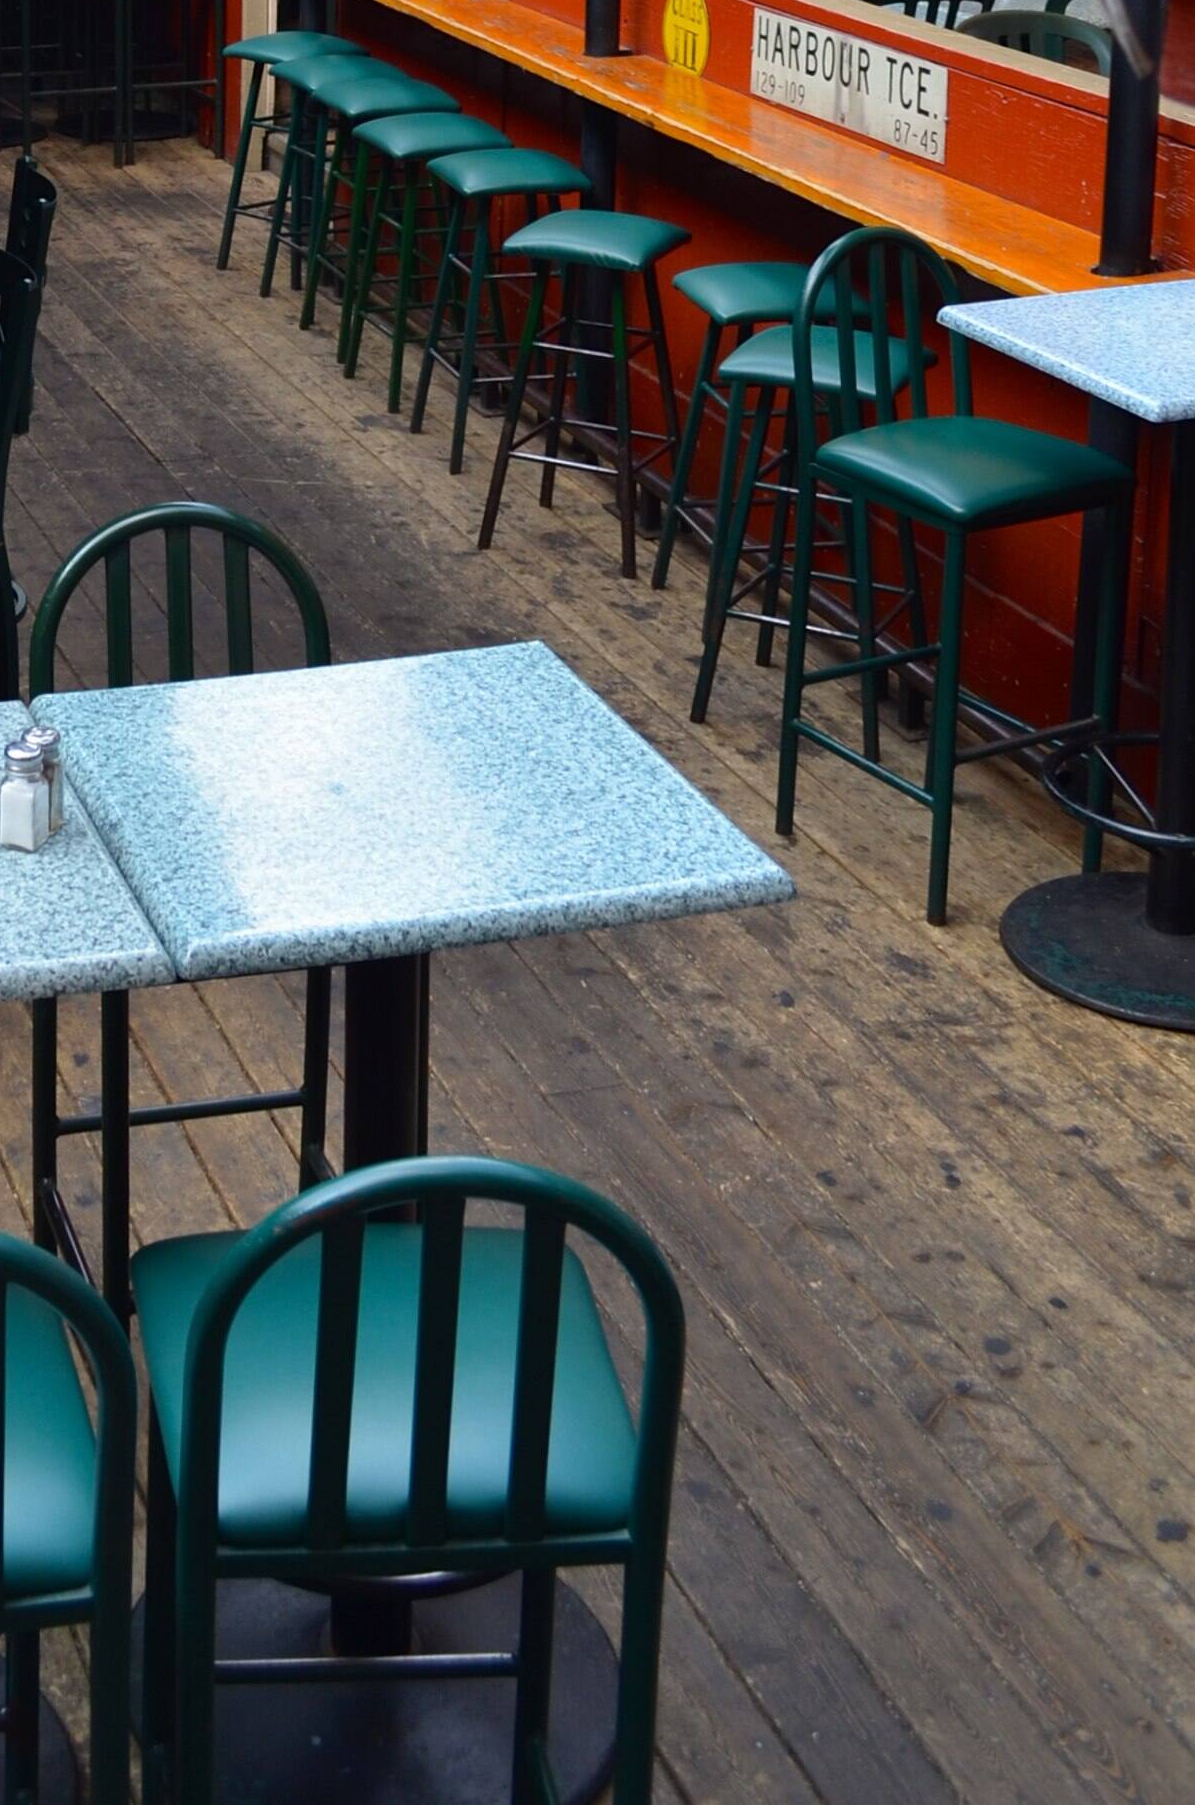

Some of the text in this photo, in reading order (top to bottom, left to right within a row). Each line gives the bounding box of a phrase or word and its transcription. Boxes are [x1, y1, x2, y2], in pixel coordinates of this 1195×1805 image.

[755, 70, 939, 156] 129-109 87-45
[757, 17, 938, 121] HARBOUR TCE.
